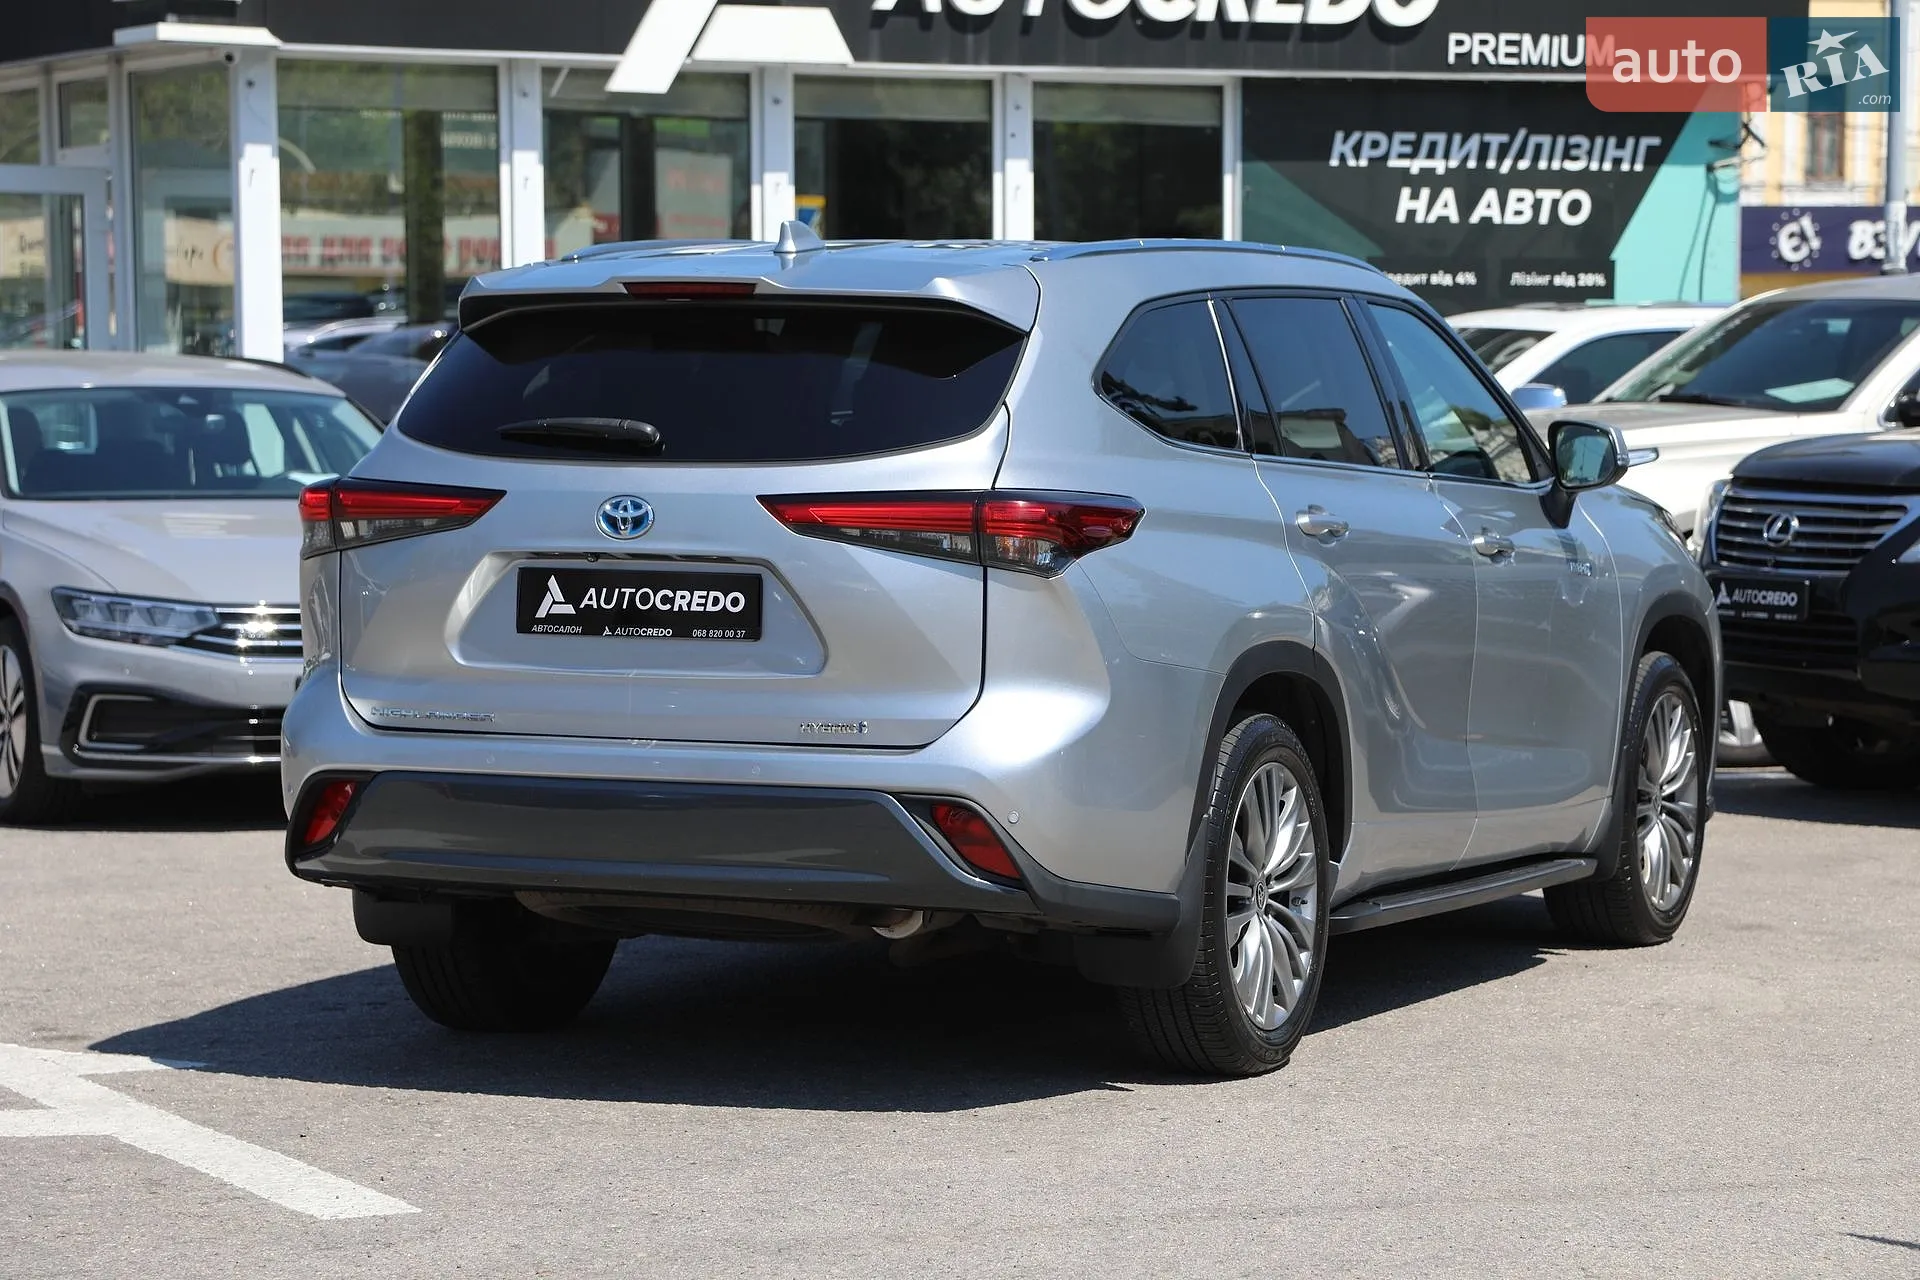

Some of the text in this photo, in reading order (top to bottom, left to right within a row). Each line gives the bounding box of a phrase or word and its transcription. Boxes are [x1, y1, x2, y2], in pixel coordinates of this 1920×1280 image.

[1448, 32, 1616, 68] PREMIUM
[1329, 128, 1662, 175] КРЕДИТ/ЛІЗІНГ
[1395, 186, 1592, 226] НА АВТО
[579, 587, 746, 613] AUTOCREDO
[1732, 588, 1798, 607] AUTOCREDO
[532, 624, 582, 634] АВТОСАЛОН
[614, 627, 673, 637] AUTOCREDO
[692, 629, 746, 639] 068 820 00 37
